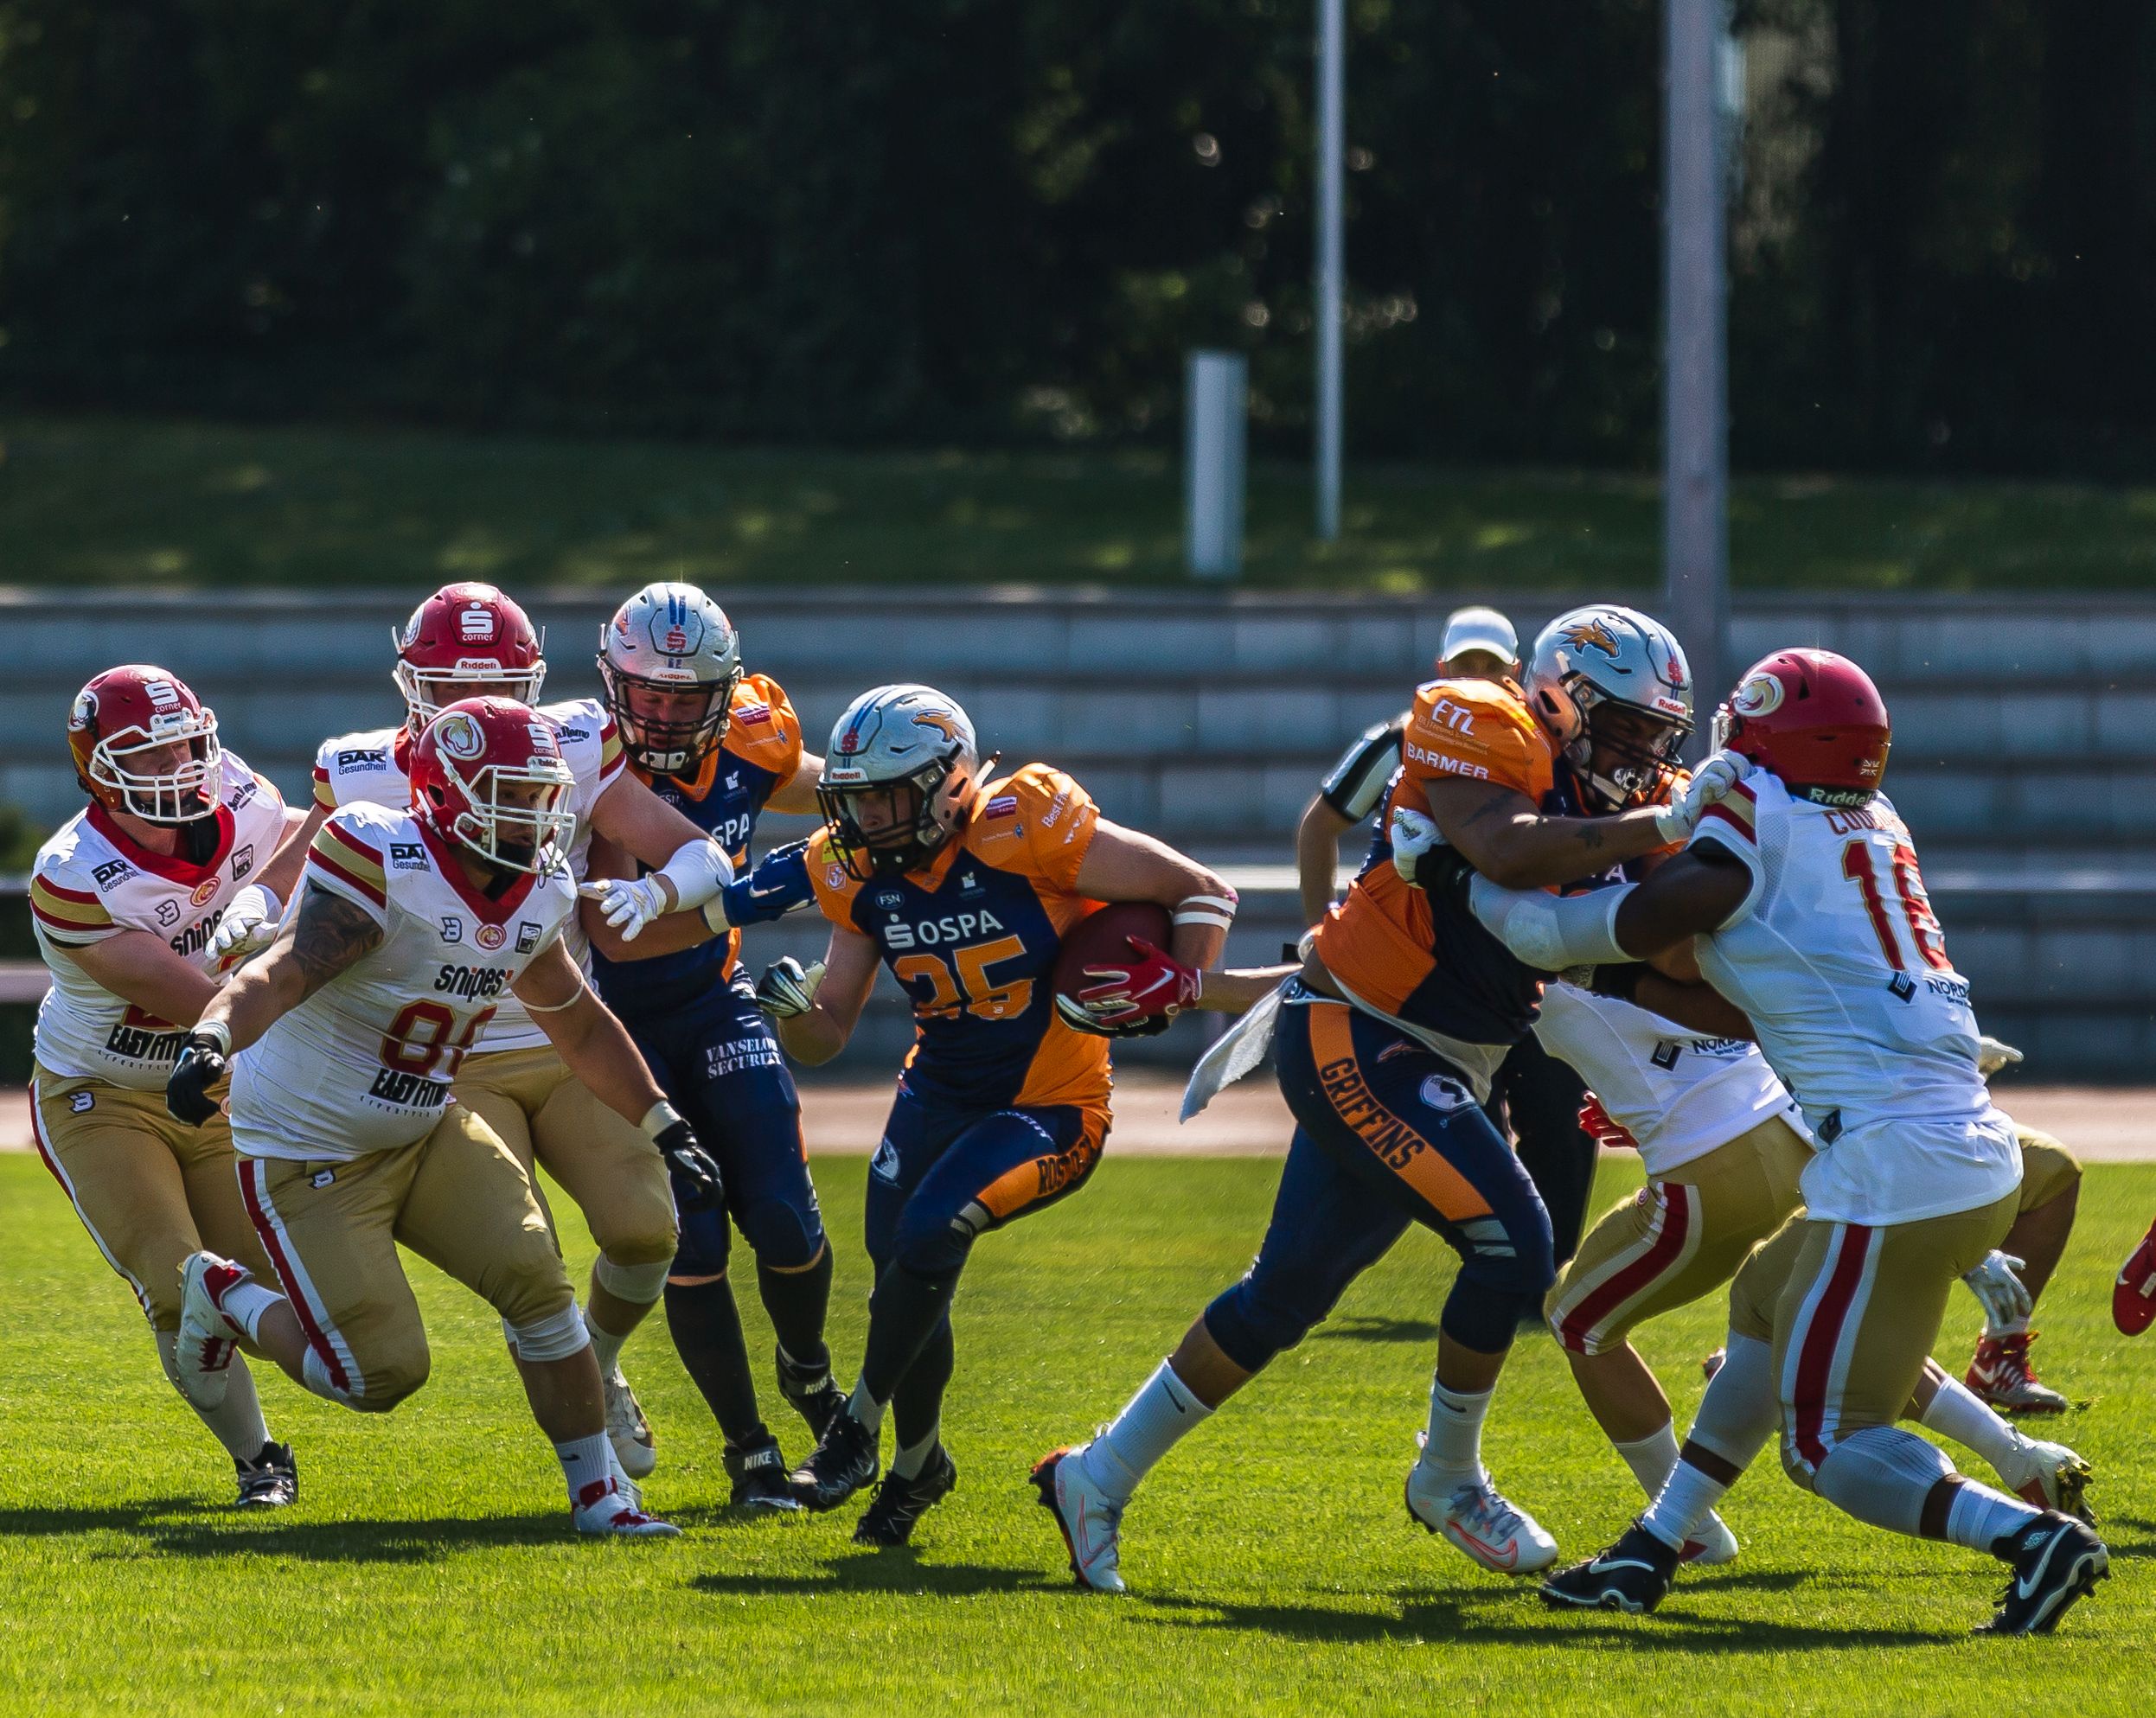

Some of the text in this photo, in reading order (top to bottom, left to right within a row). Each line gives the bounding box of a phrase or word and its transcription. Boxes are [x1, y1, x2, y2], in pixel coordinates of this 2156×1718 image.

[155, 702, 182, 713] corner
[1432, 699, 1475, 736] ETL
[338, 750, 386, 766] DAK
[1407, 741, 1489, 779] BARMER
[338, 763, 387, 775] Gesundheit
[880, 894, 901, 905] FSN
[918, 910, 1004, 945] OSPA
[1320, 1057, 1426, 1171] GRIFFINS
[745, 1451, 772, 1470] NIKE
